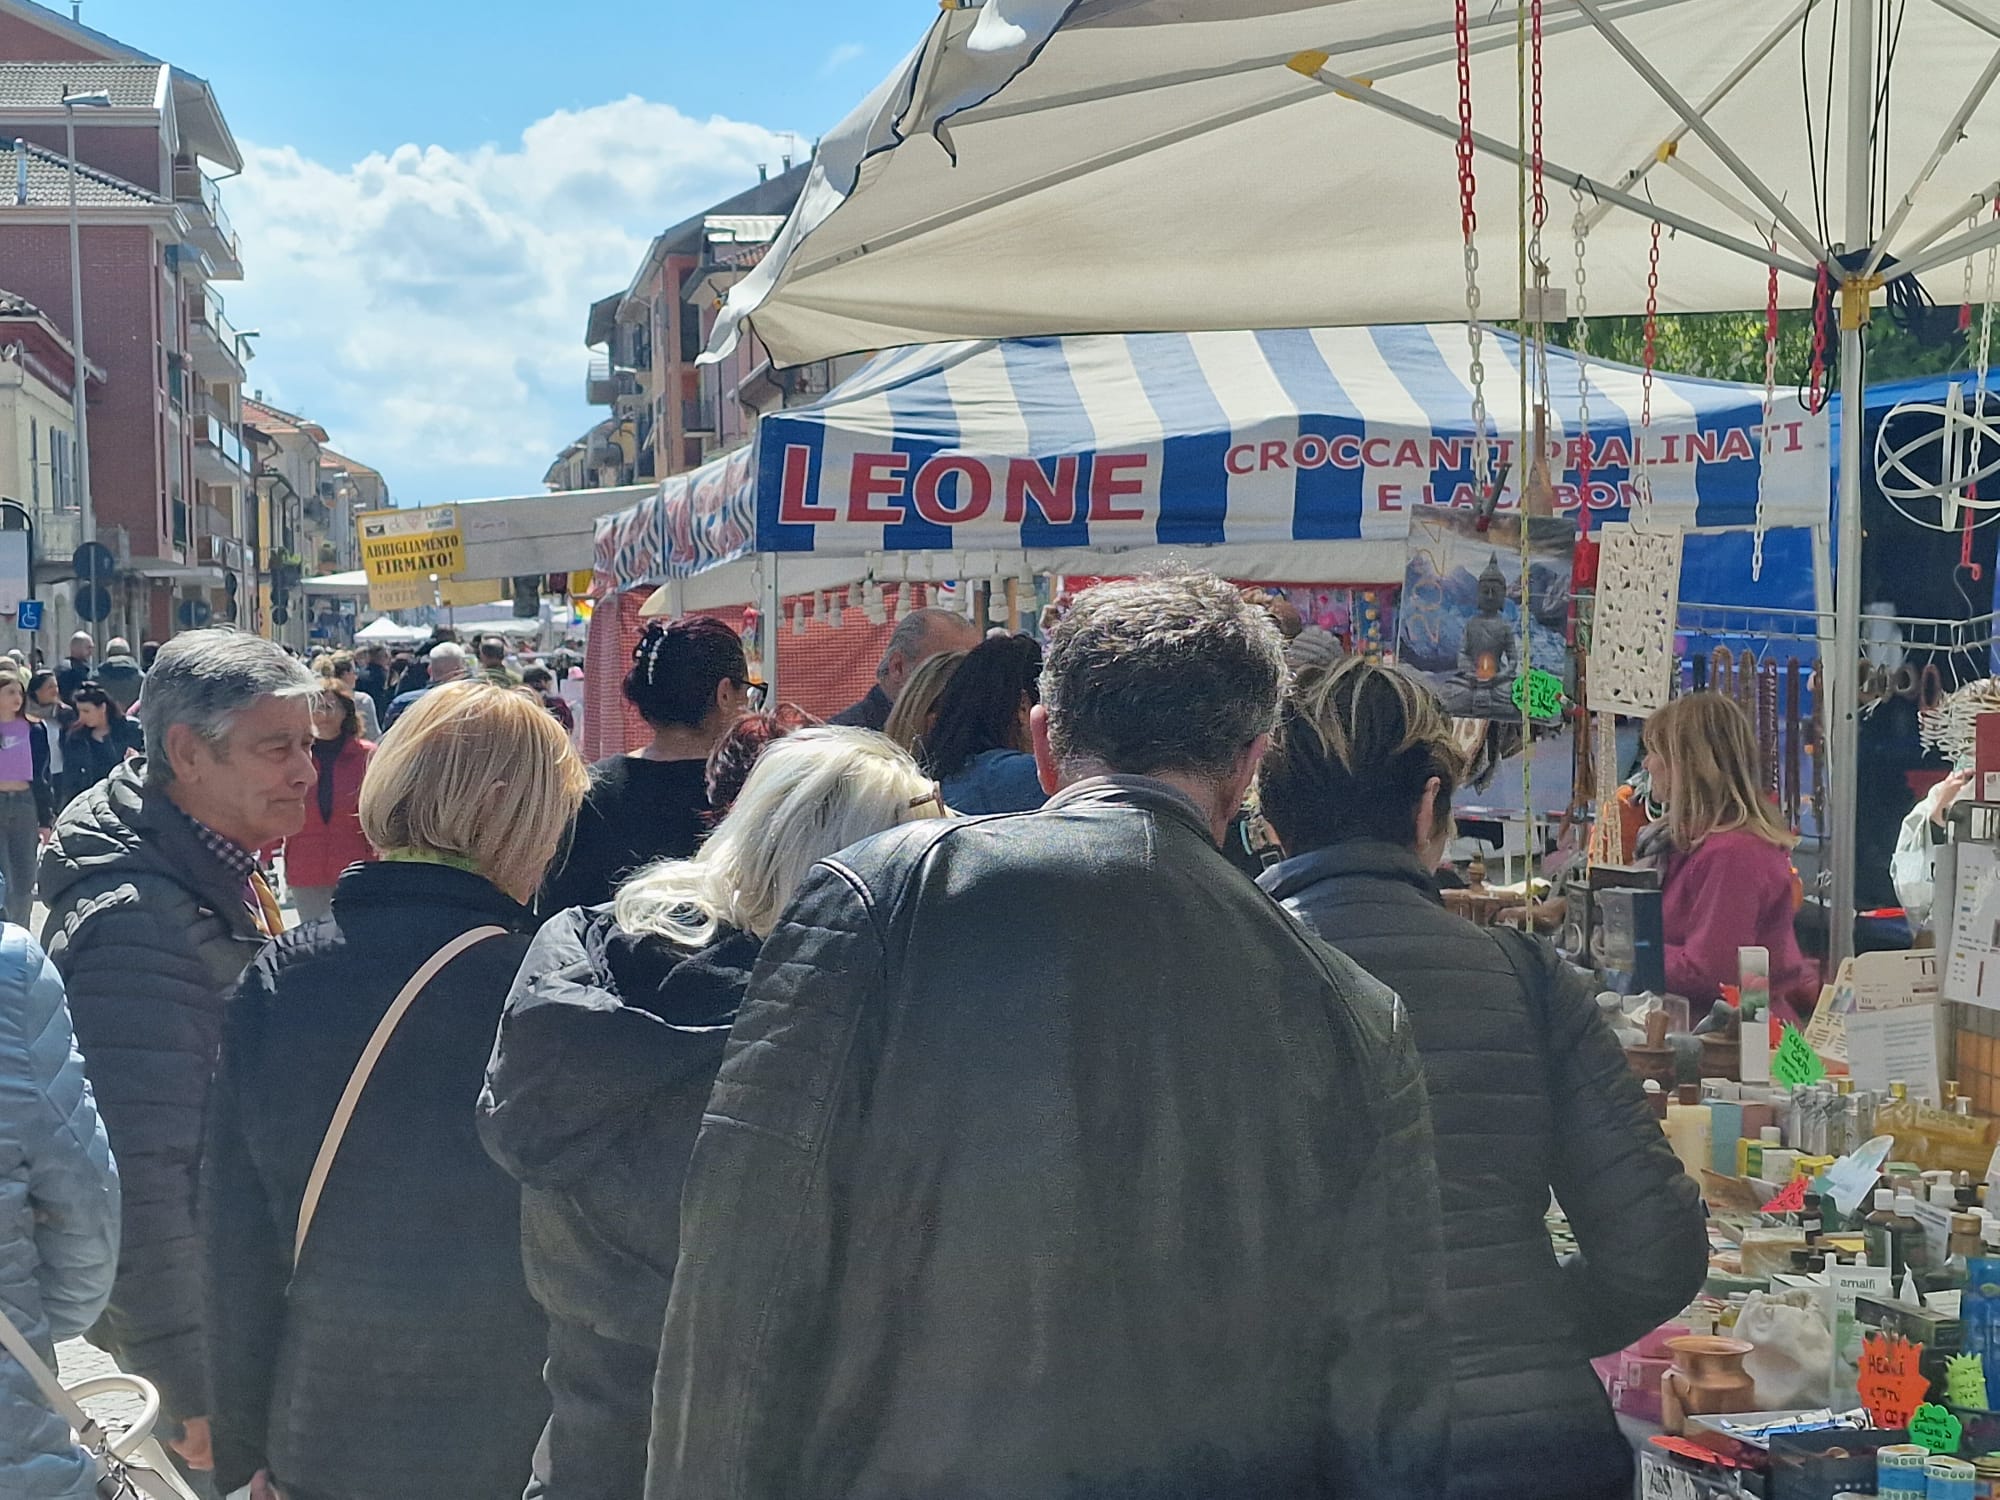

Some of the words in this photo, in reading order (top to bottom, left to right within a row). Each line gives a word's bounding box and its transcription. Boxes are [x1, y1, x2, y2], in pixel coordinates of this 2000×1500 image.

[1226, 435, 1514, 475] CROCCANTI
[779, 445, 1147, 524] LEONE
[1378, 484, 1402, 511] E
[1422, 482, 1652, 509] LACBON
[366, 535, 459, 558] ABBIGLIAMENTO
[376, 551, 454, 576] FIRMATO!
